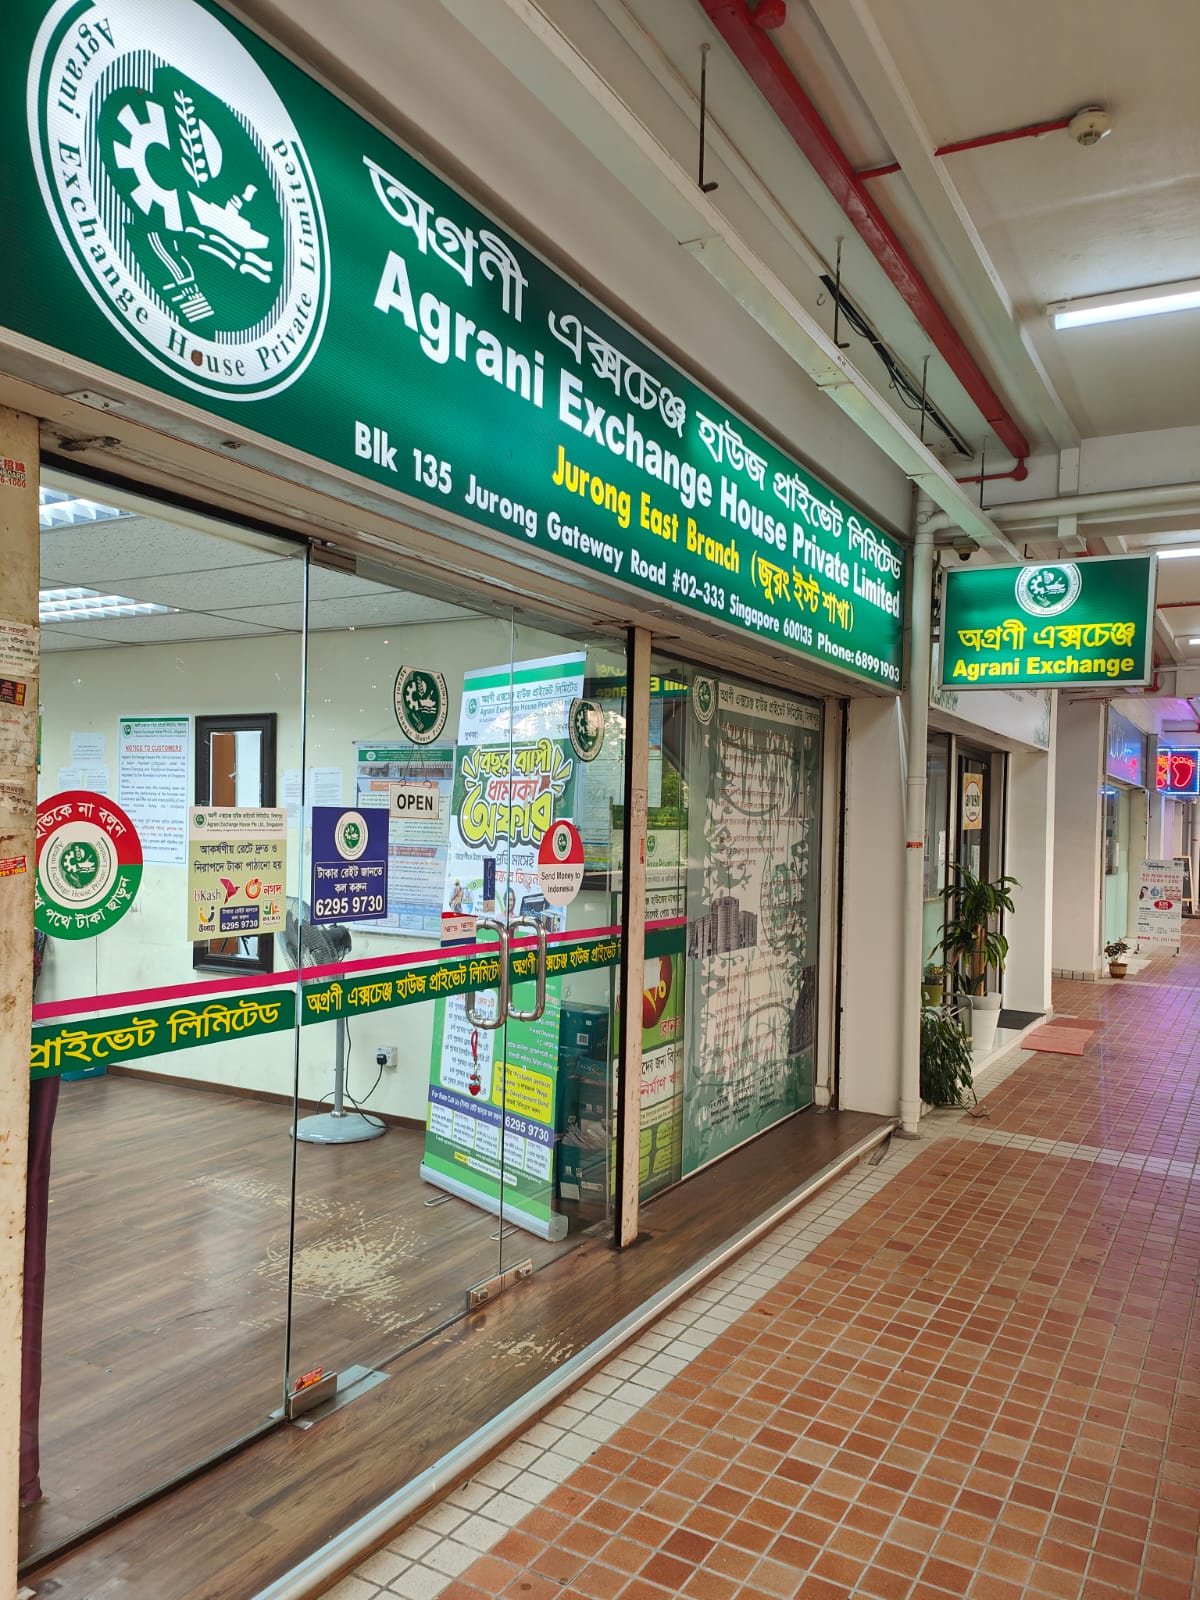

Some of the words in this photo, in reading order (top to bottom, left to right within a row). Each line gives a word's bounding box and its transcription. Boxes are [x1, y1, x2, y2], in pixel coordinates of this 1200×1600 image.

[57, 17, 116, 120] Agrani
[271, 138, 317, 276] Limited
[57, 137, 150, 327] Exchange
[255, 292, 313, 372] Private
[166, 326, 247, 377] Huse
[373, 249, 545, 409] Agrani
[559, 367, 713, 510] Exchange
[719, 474, 788, 552] House
[792, 521, 850, 588] Private
[852, 561, 900, 619] Limited
[548, 310, 687, 438] এক্সচেঞ্জ
[695, 410, 768, 491] হাউজ
[772, 471, 844, 538] প্রাইভেট
[846, 515, 902, 580] লিমিটেড
[552, 444, 632, 529] Jurong
[640, 491, 679, 543] East
[686, 517, 740, 574] Branch
[354, 420, 399, 472] Blk
[413, 447, 453, 495] 135
[464, 473, 538, 539] Jurong
[546, 510, 624, 574] Gateway
[630, 548, 667, 586] Road
[671, 567, 725, 611] #02-333
[729, 592, 780, 633] Singapore
[782, 617, 813, 647] 600135
[792, 564, 820, 613] ইস্ট
[957, 618, 1027, 652] অগ্রণী
[1033, 622, 1136, 651] এক্সচেঞ্জ
[952, 657, 1020, 681] Agrani
[1026, 655, 1136, 677] Exchange
[397, 793, 434, 811] OPEN
[77, 802, 96, 818] না
[98, 806, 128, 838] বলুন
[271, 844, 278, 853] ও
[512, 852, 535, 868] মাসেই
[193, 860, 225, 873] নিরাপদে
[226, 860, 243, 872] টাকা
[245, 858, 271, 871] পাঠানো
[316, 866, 339, 880] টাকার
[341, 864, 360, 880] রেইট
[360, 866, 384, 878] জানতে
[541, 871, 556, 881] Send
[556, 871, 575, 882] Money
[194, 887, 221, 902] bKash
[262, 884, 283, 896] নগদ
[333, 883, 348, 894] কল
[547, 884, 575, 893] Indonesia
[74, 909, 107, 929] টাকা
[315, 896, 349, 916] 6295
[352, 894, 384, 914] 9730
[221, 921, 240, 931] 6295
[240, 919, 259, 929] 9730
[460, 921, 474, 929] NETS
[512, 951, 536, 977] অগ্রণী
[570, 946, 590, 968] হাউজ
[591, 940, 617, 963] প্রাইভেট
[306, 982, 343, 1014] অগ্রণী
[347, 982, 393, 1007] এক্সচেঞ্জ
[396, 971, 428, 999] হাউজ
[429, 962, 467, 992] প্রাইভেট
[30, 1015, 159, 1069] প্রাইভেট
[166, 1000, 282, 1044] লিমিটেড
[504, 1115, 526, 1133] 6295
[527, 1124, 550, 1143] 9730
